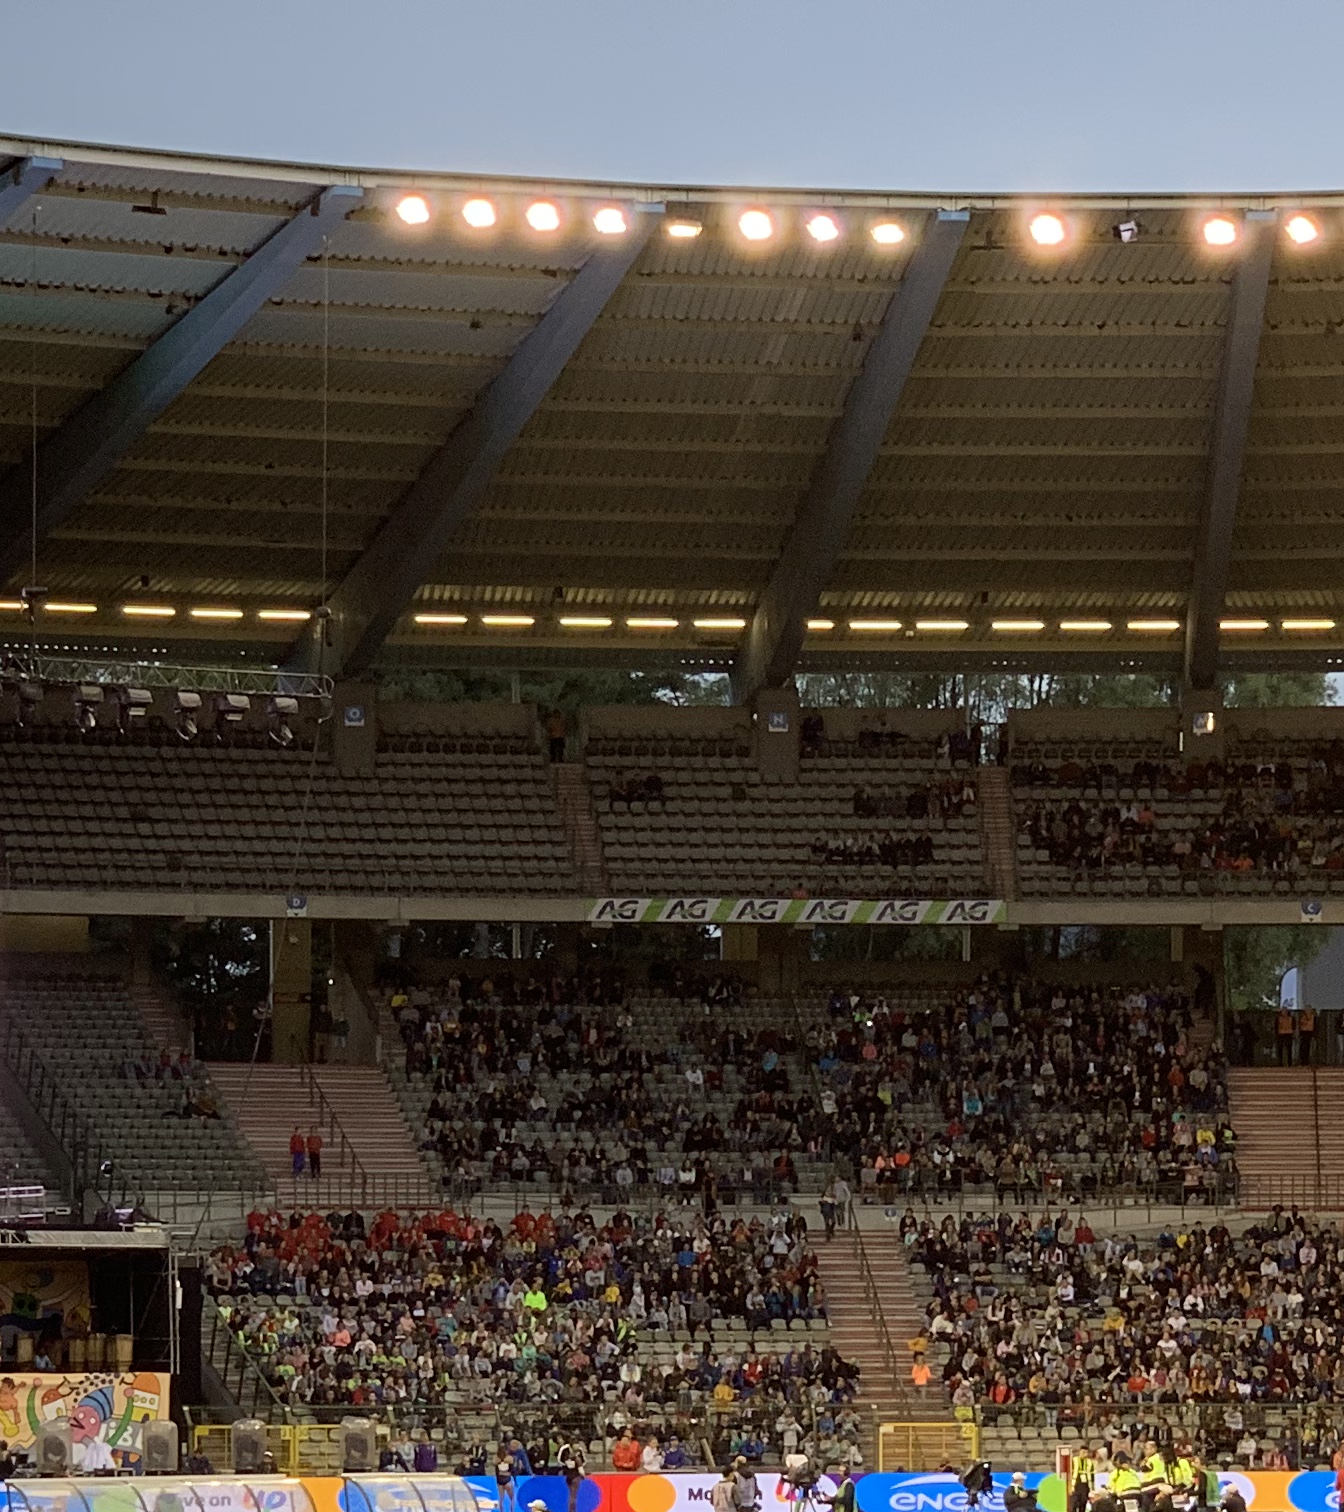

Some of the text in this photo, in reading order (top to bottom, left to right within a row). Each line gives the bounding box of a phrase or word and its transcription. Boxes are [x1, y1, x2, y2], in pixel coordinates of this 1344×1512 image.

[595, 900, 989, 921] AG AG AG AG AG AG
